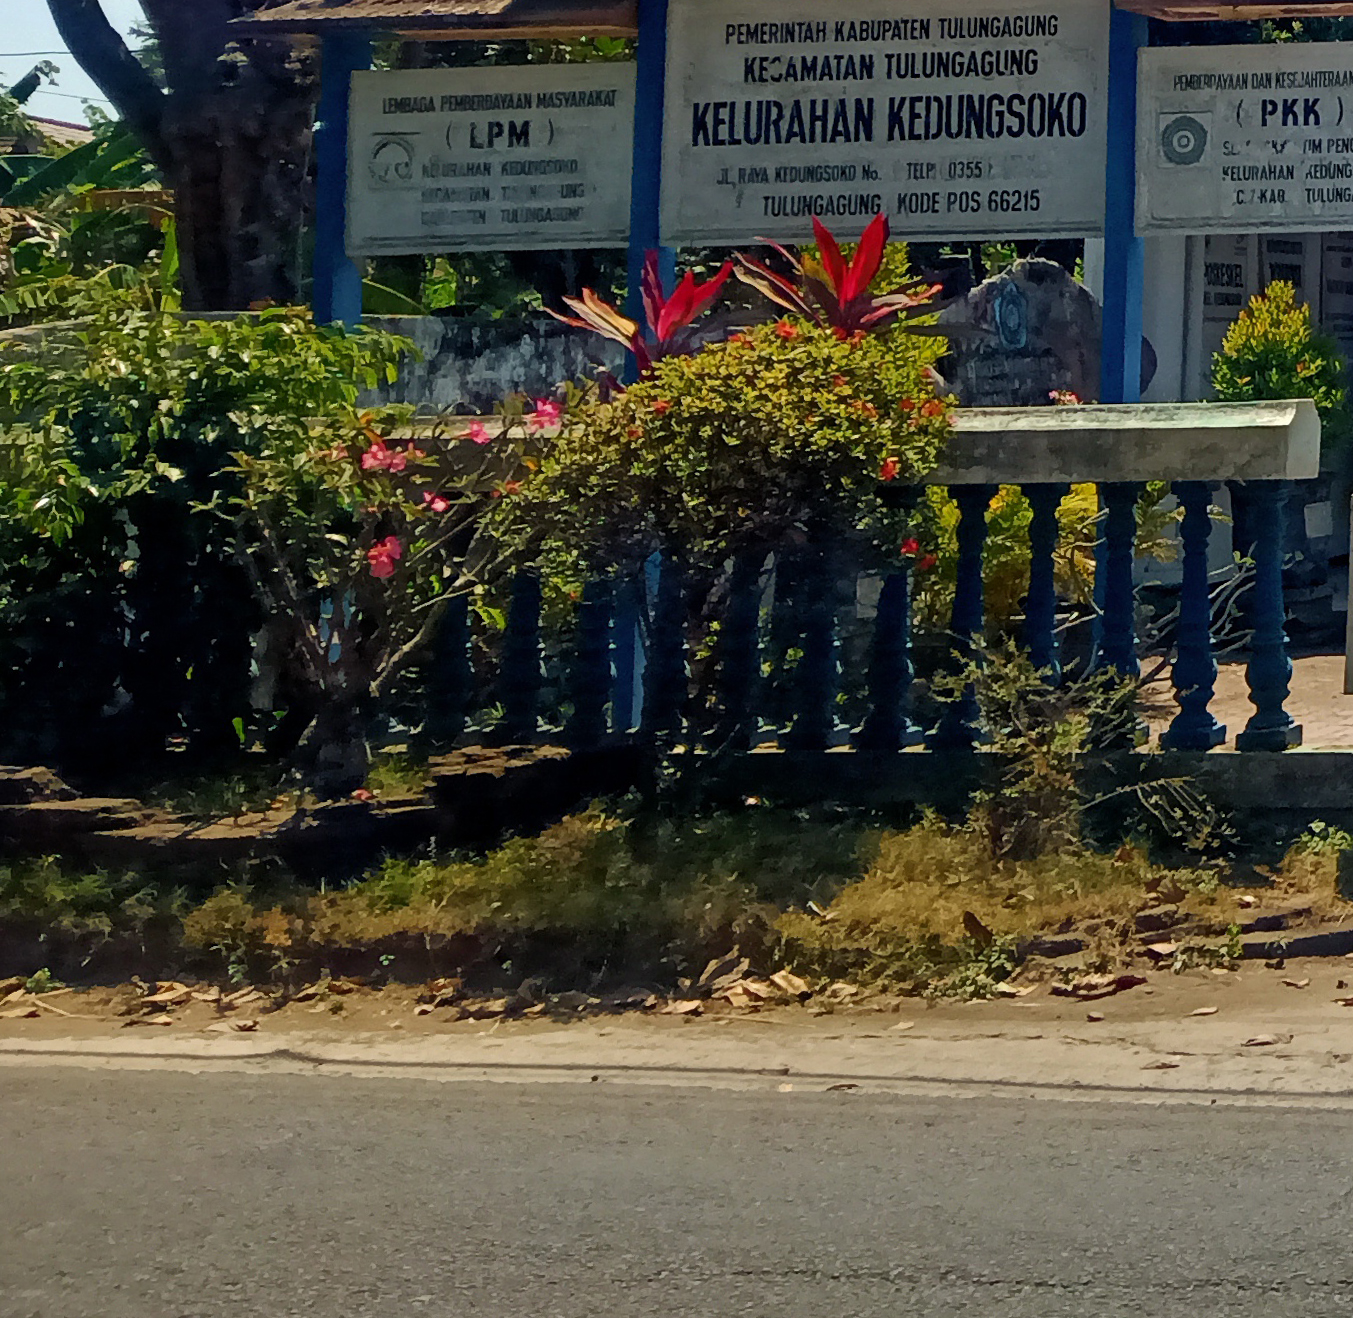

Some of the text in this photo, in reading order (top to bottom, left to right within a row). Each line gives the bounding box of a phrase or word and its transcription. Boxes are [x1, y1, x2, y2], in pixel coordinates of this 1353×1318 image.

[725, 14, 1058, 45] PEMERINTAH KABUPATEN TULUNGAGUNG
[744, 49, 1039, 84] KECAMATAN TULUNGAGUNG
[1173, 72, 1248, 91] PEMBERDAYAAN
[1251, 71, 1272, 89] DAN
[382, 89, 617, 115] LEMBAGA PEMBERDAYAAN MASYARAKAT
[1261, 97, 1321, 127] PKK
[691, 91, 1087, 147] KELURAHAN KEDUNGSOKO
[469, 119, 531, 149] LPM
[775, 165, 857, 184] KEDUNGSOKO
[1222, 164, 1294, 182] KELURAHAN
[763, 189, 1040, 218] TULUNGAGUNG KODE POS 66215
